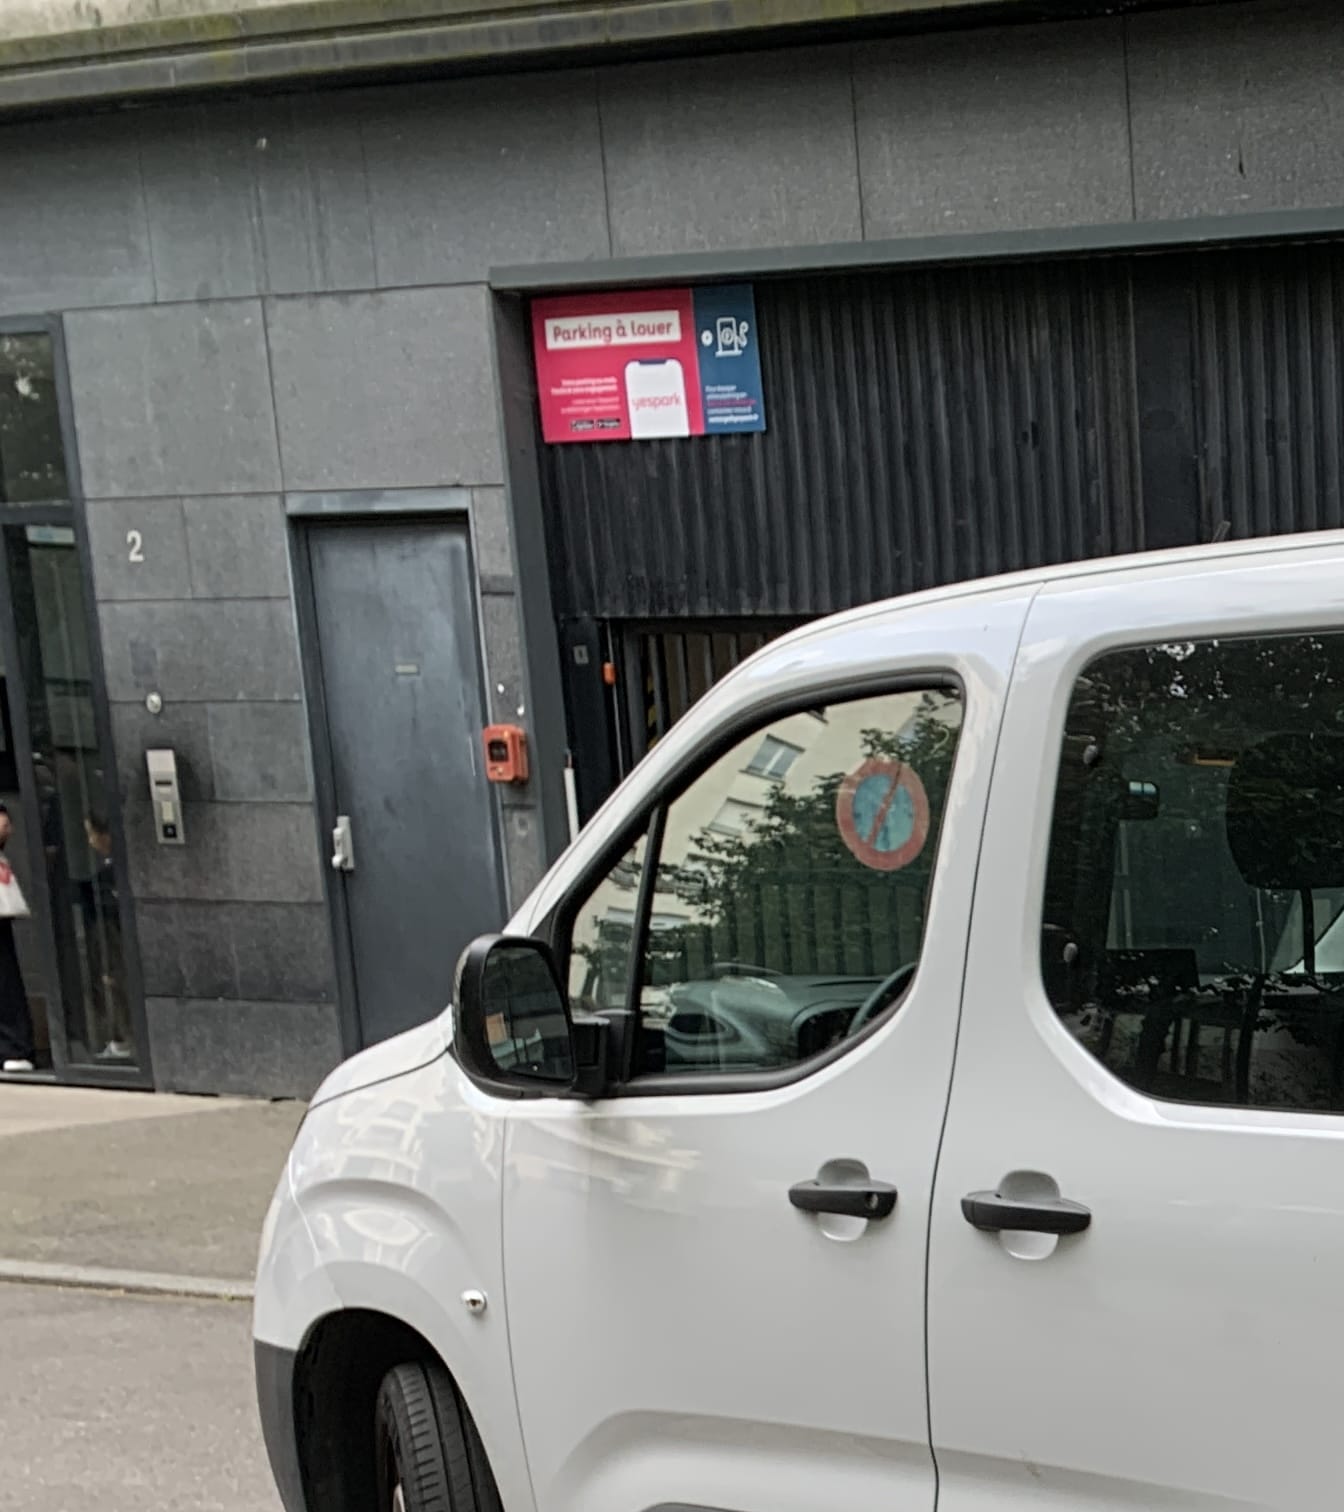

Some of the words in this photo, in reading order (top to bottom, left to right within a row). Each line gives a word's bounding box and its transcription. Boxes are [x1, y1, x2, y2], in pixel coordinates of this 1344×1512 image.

[553, 321, 612, 344] Parking
[616, 319, 627, 338] à
[630, 320, 673, 337] louer
[632, 391, 682, 410] yespark
[127, 529, 145, 564] 2
